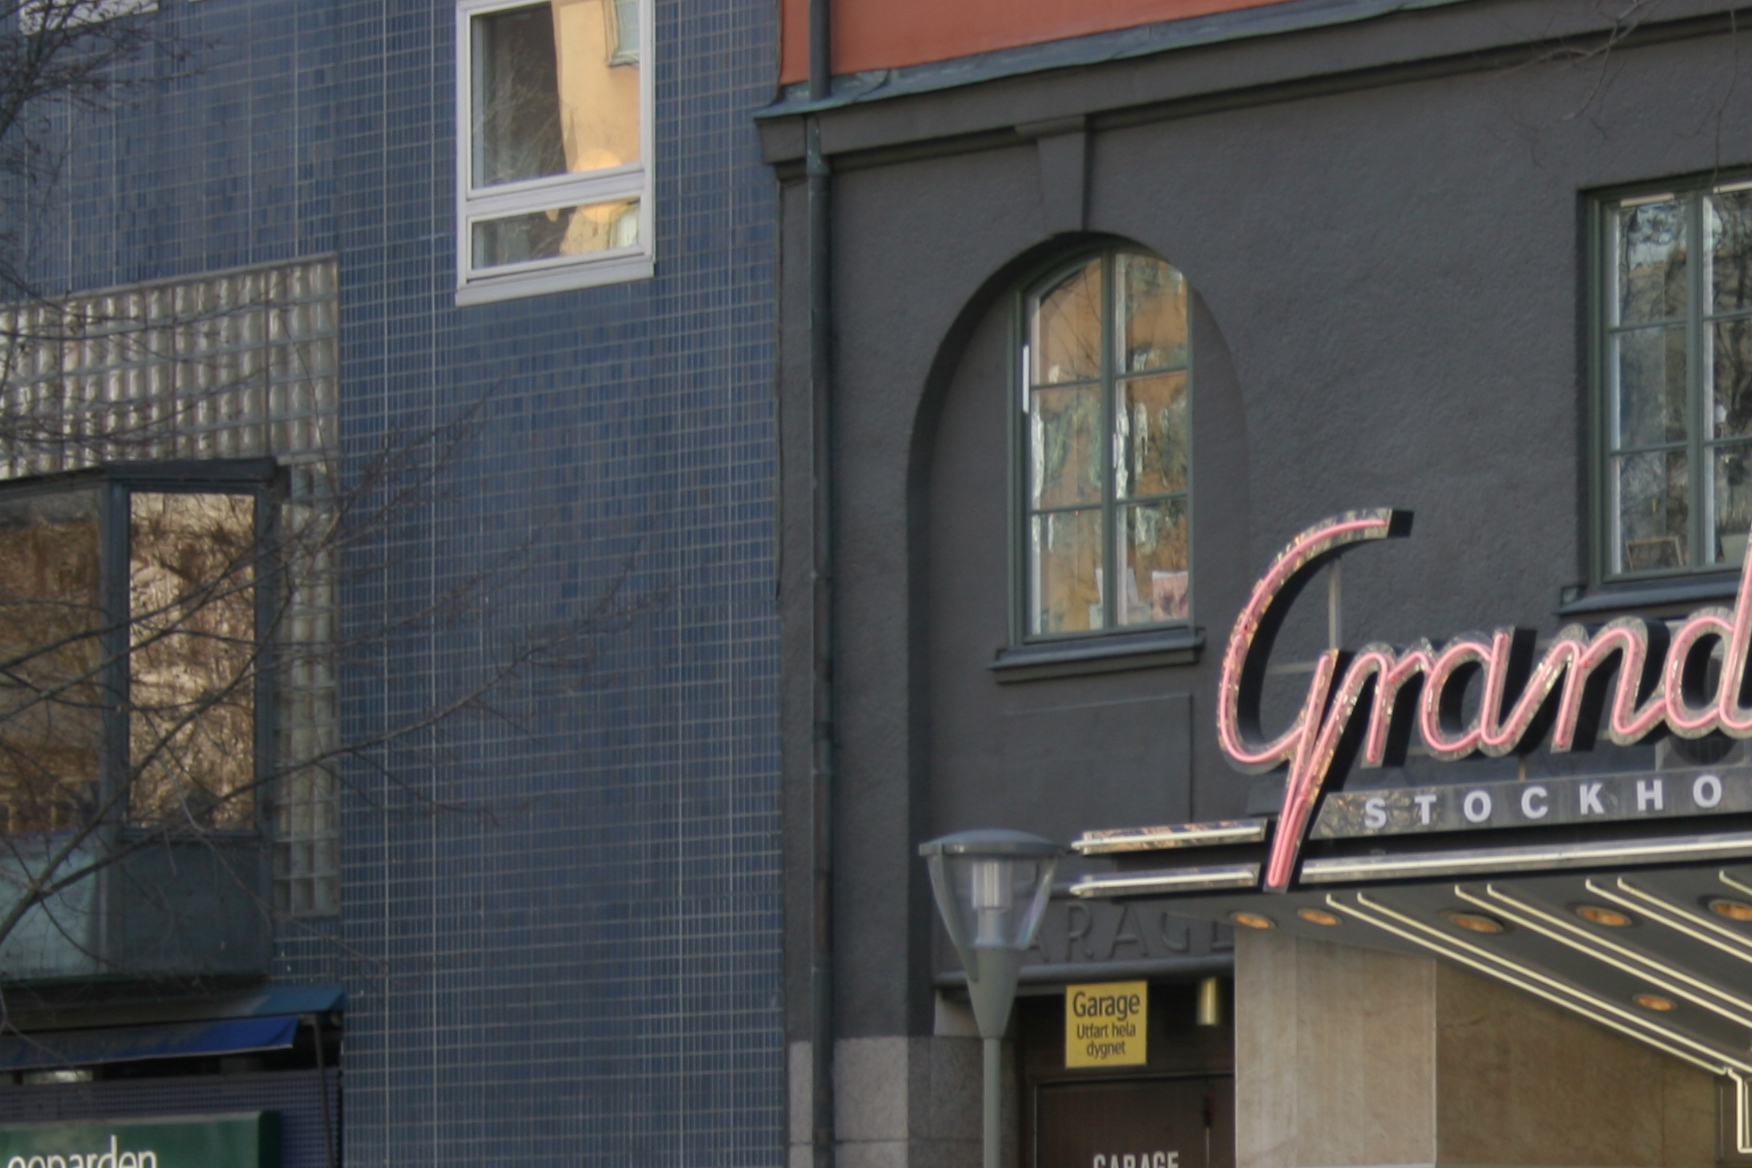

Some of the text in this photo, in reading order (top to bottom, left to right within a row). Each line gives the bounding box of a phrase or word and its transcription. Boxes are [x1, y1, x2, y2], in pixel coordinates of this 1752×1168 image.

[1072, 990, 1141, 1021] Garage
[1076, 1020, 1136, 1040] Utfart hela
[1086, 1040, 1126, 1059] dygnet
